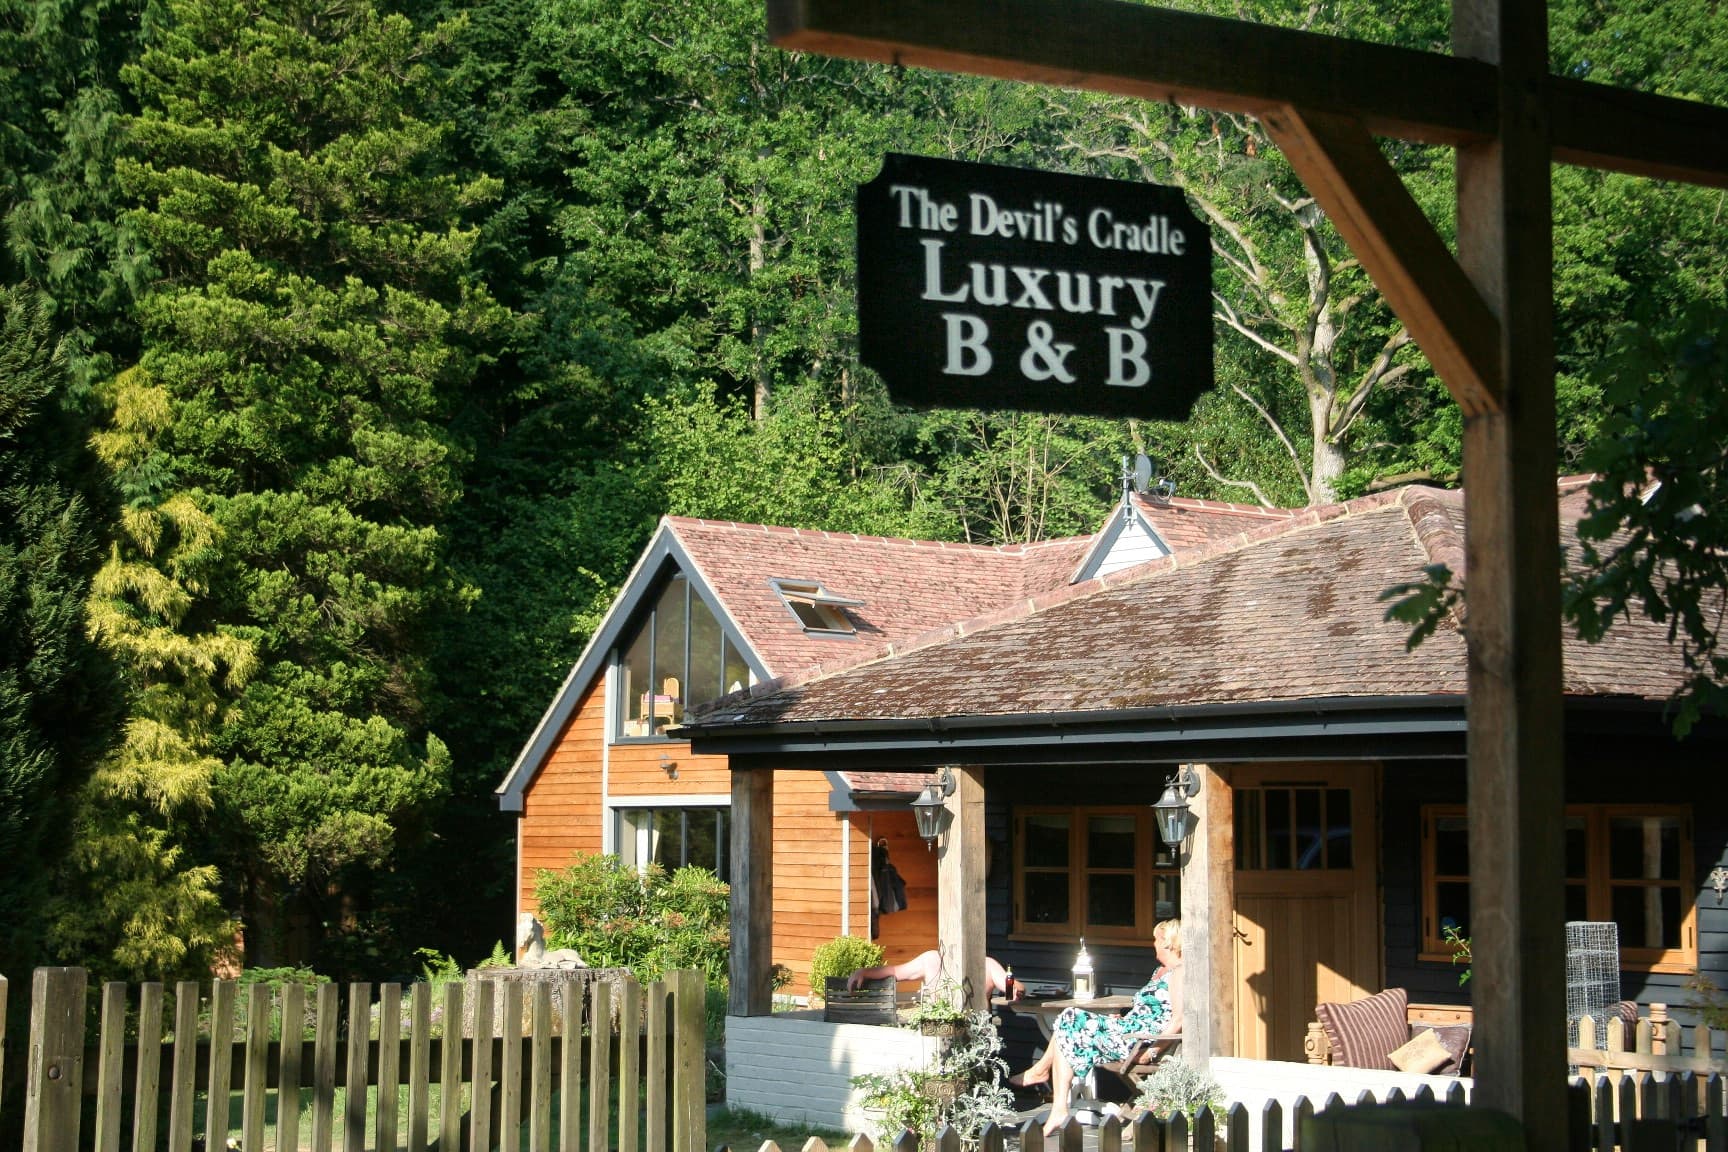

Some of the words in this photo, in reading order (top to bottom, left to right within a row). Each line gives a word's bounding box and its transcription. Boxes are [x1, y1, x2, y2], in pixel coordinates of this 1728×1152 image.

[890, 185, 958, 232] The
[969, 193, 1078, 245] Devil's
[1088, 208, 1186, 256] Cradle
[920, 239, 1166, 330] Luxury
[942, 313, 993, 376] B
[1020, 320, 1077, 384] &
[1105, 327, 1150, 387] B
